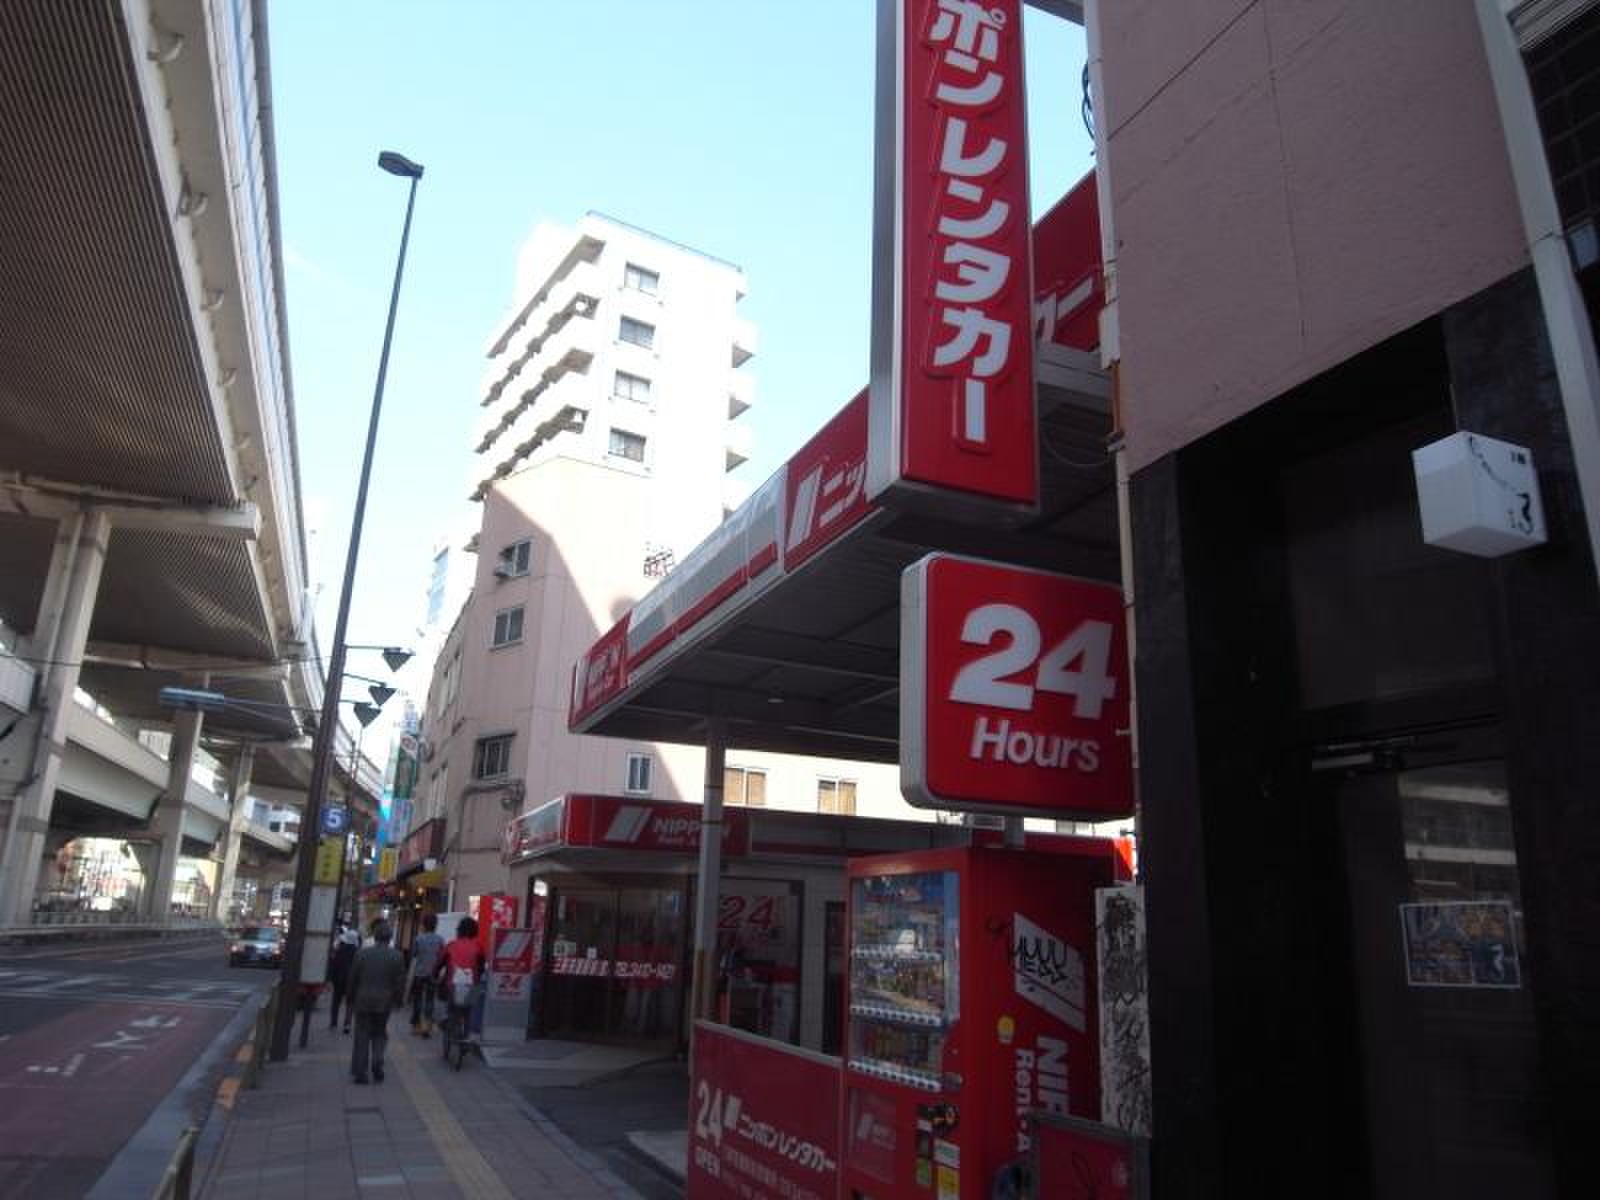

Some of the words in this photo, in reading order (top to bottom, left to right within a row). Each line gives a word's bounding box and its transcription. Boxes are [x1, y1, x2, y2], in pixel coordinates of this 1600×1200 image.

[949, 603, 1116, 719] 24
[968, 716, 1100, 772] Hours
[326, 808, 343, 829] 5
